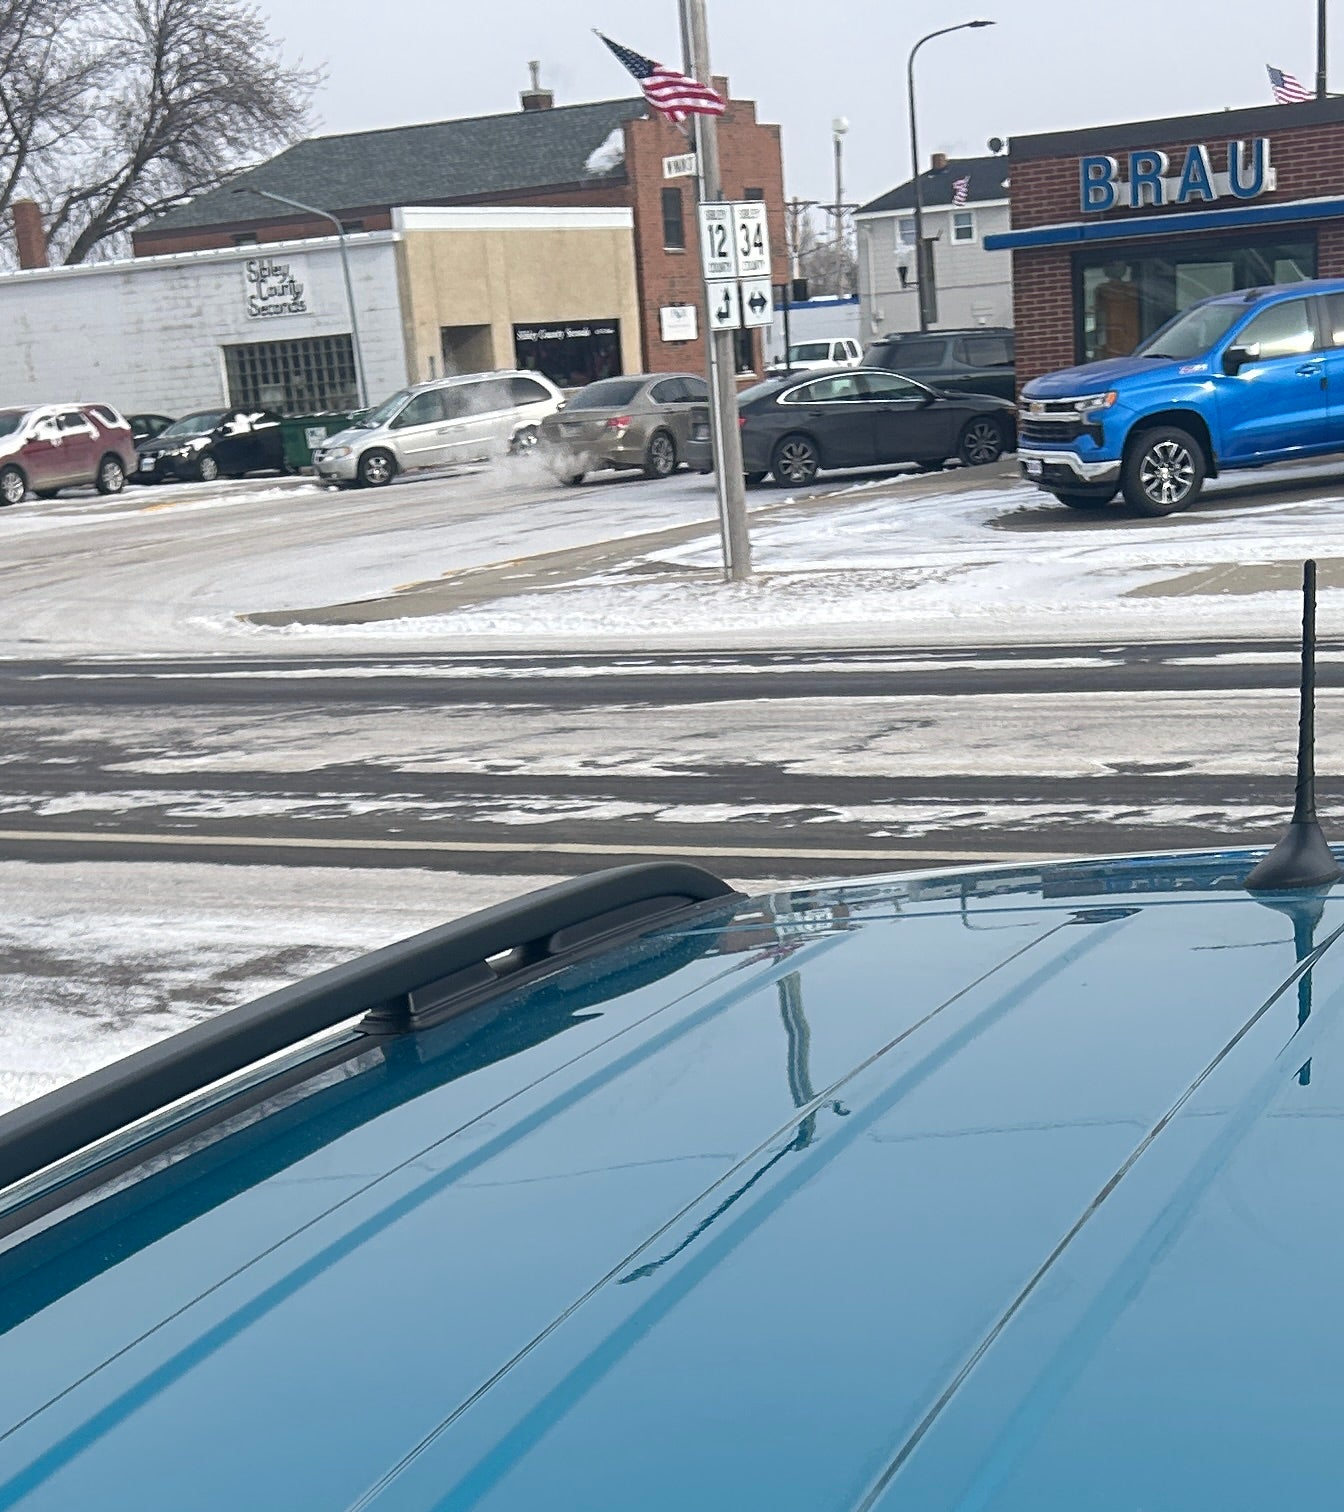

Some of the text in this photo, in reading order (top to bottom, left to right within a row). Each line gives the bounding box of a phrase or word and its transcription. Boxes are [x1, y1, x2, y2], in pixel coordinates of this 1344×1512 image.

[1080, 137, 1272, 213] BRAU
[707, 224, 728, 259] 12
[740, 222, 764, 257] 34
